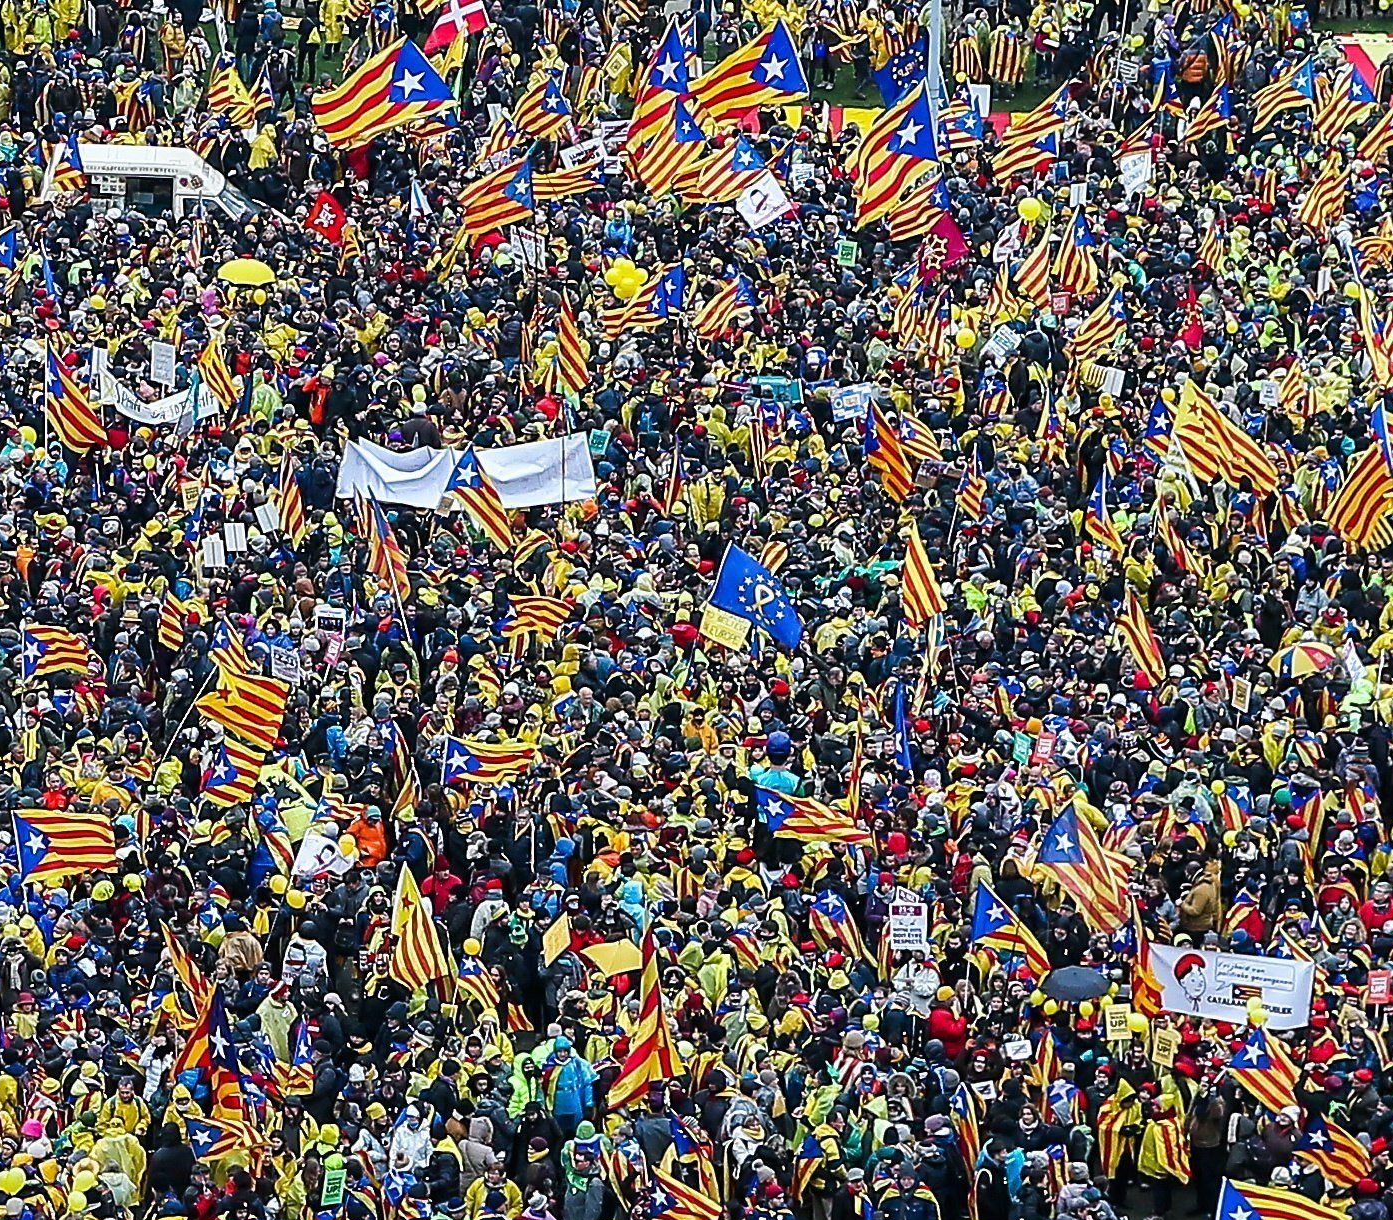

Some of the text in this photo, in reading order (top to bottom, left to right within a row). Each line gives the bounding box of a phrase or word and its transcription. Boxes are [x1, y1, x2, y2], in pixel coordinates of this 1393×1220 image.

[1207, 995, 1293, 1016] CATALAAN PUBLIEK
[1110, 1020, 1128, 1028] UP!
